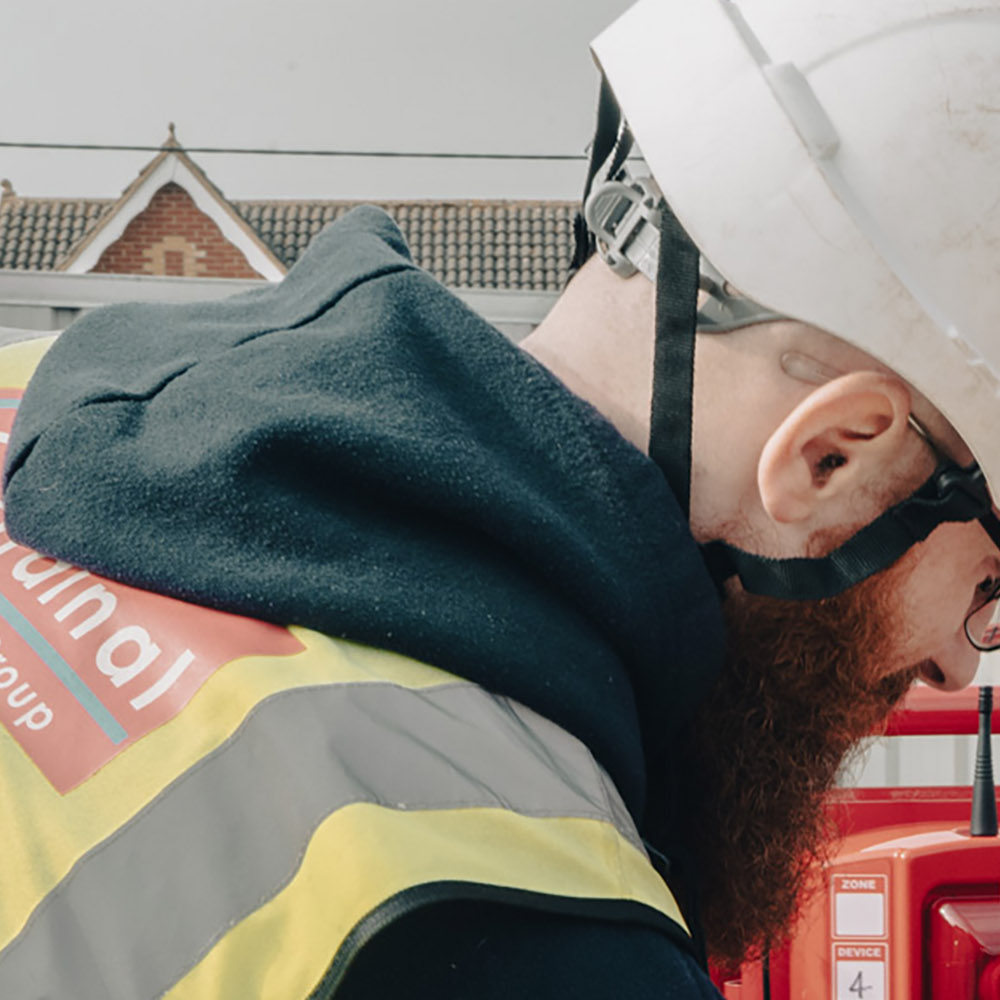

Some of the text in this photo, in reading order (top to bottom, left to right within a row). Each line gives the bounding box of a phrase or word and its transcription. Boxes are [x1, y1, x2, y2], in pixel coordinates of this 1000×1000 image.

[841, 879, 876, 890] ZONE
[837, 947, 881, 957] DEVICE
[849, 970, 873, 999] 4
